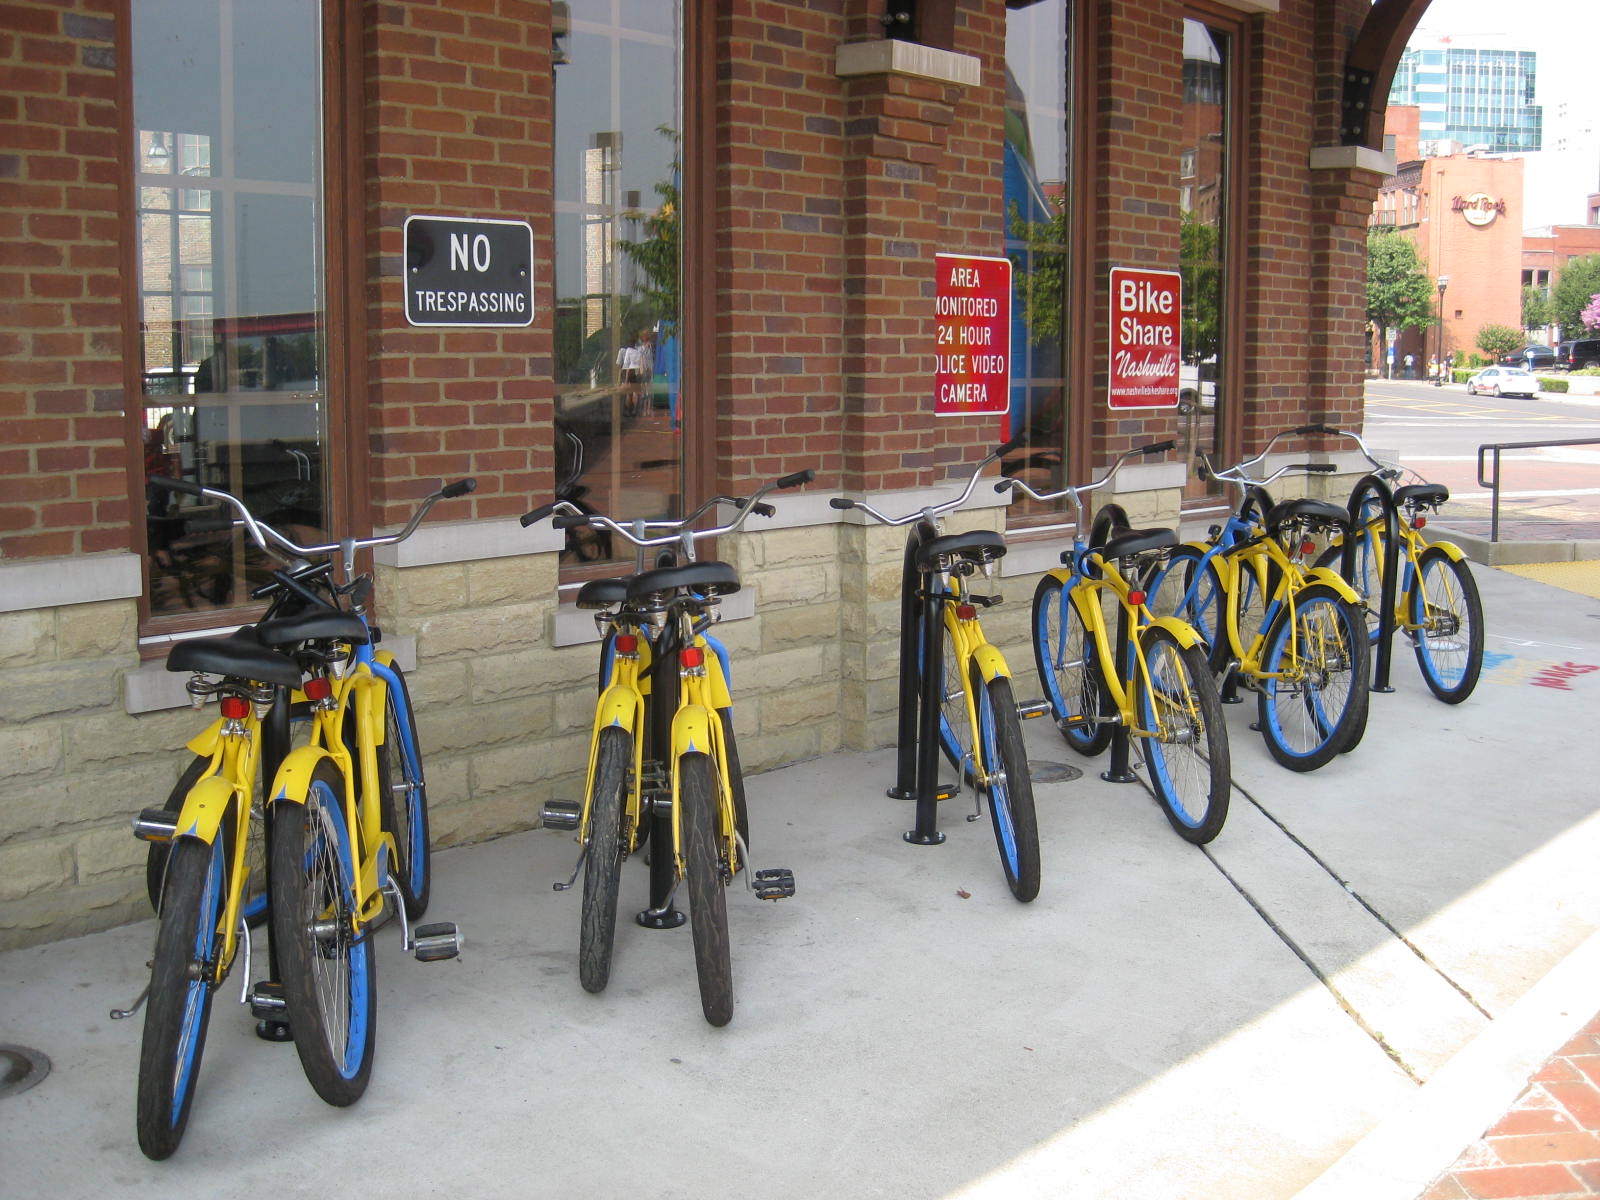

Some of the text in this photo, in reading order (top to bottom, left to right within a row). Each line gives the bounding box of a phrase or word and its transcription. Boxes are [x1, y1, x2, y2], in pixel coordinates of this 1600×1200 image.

[1452, 195, 1506, 213] Hard Rock
[450, 233, 491, 273] NO
[950, 267, 980, 288] AREA
[415, 290, 525, 313] TRESPASSING
[1120, 279, 1173, 314] Bike
[938, 325, 991, 346] 24 HOUR
[1120, 316, 1173, 346] Share
[934, 355, 1004, 374] LICE VIDEO
[1115, 349, 1176, 379] Nashville
[940, 383, 988, 403] CAMERA
[1111, 385, 1178, 398] www.nashvillebikeshare.org
